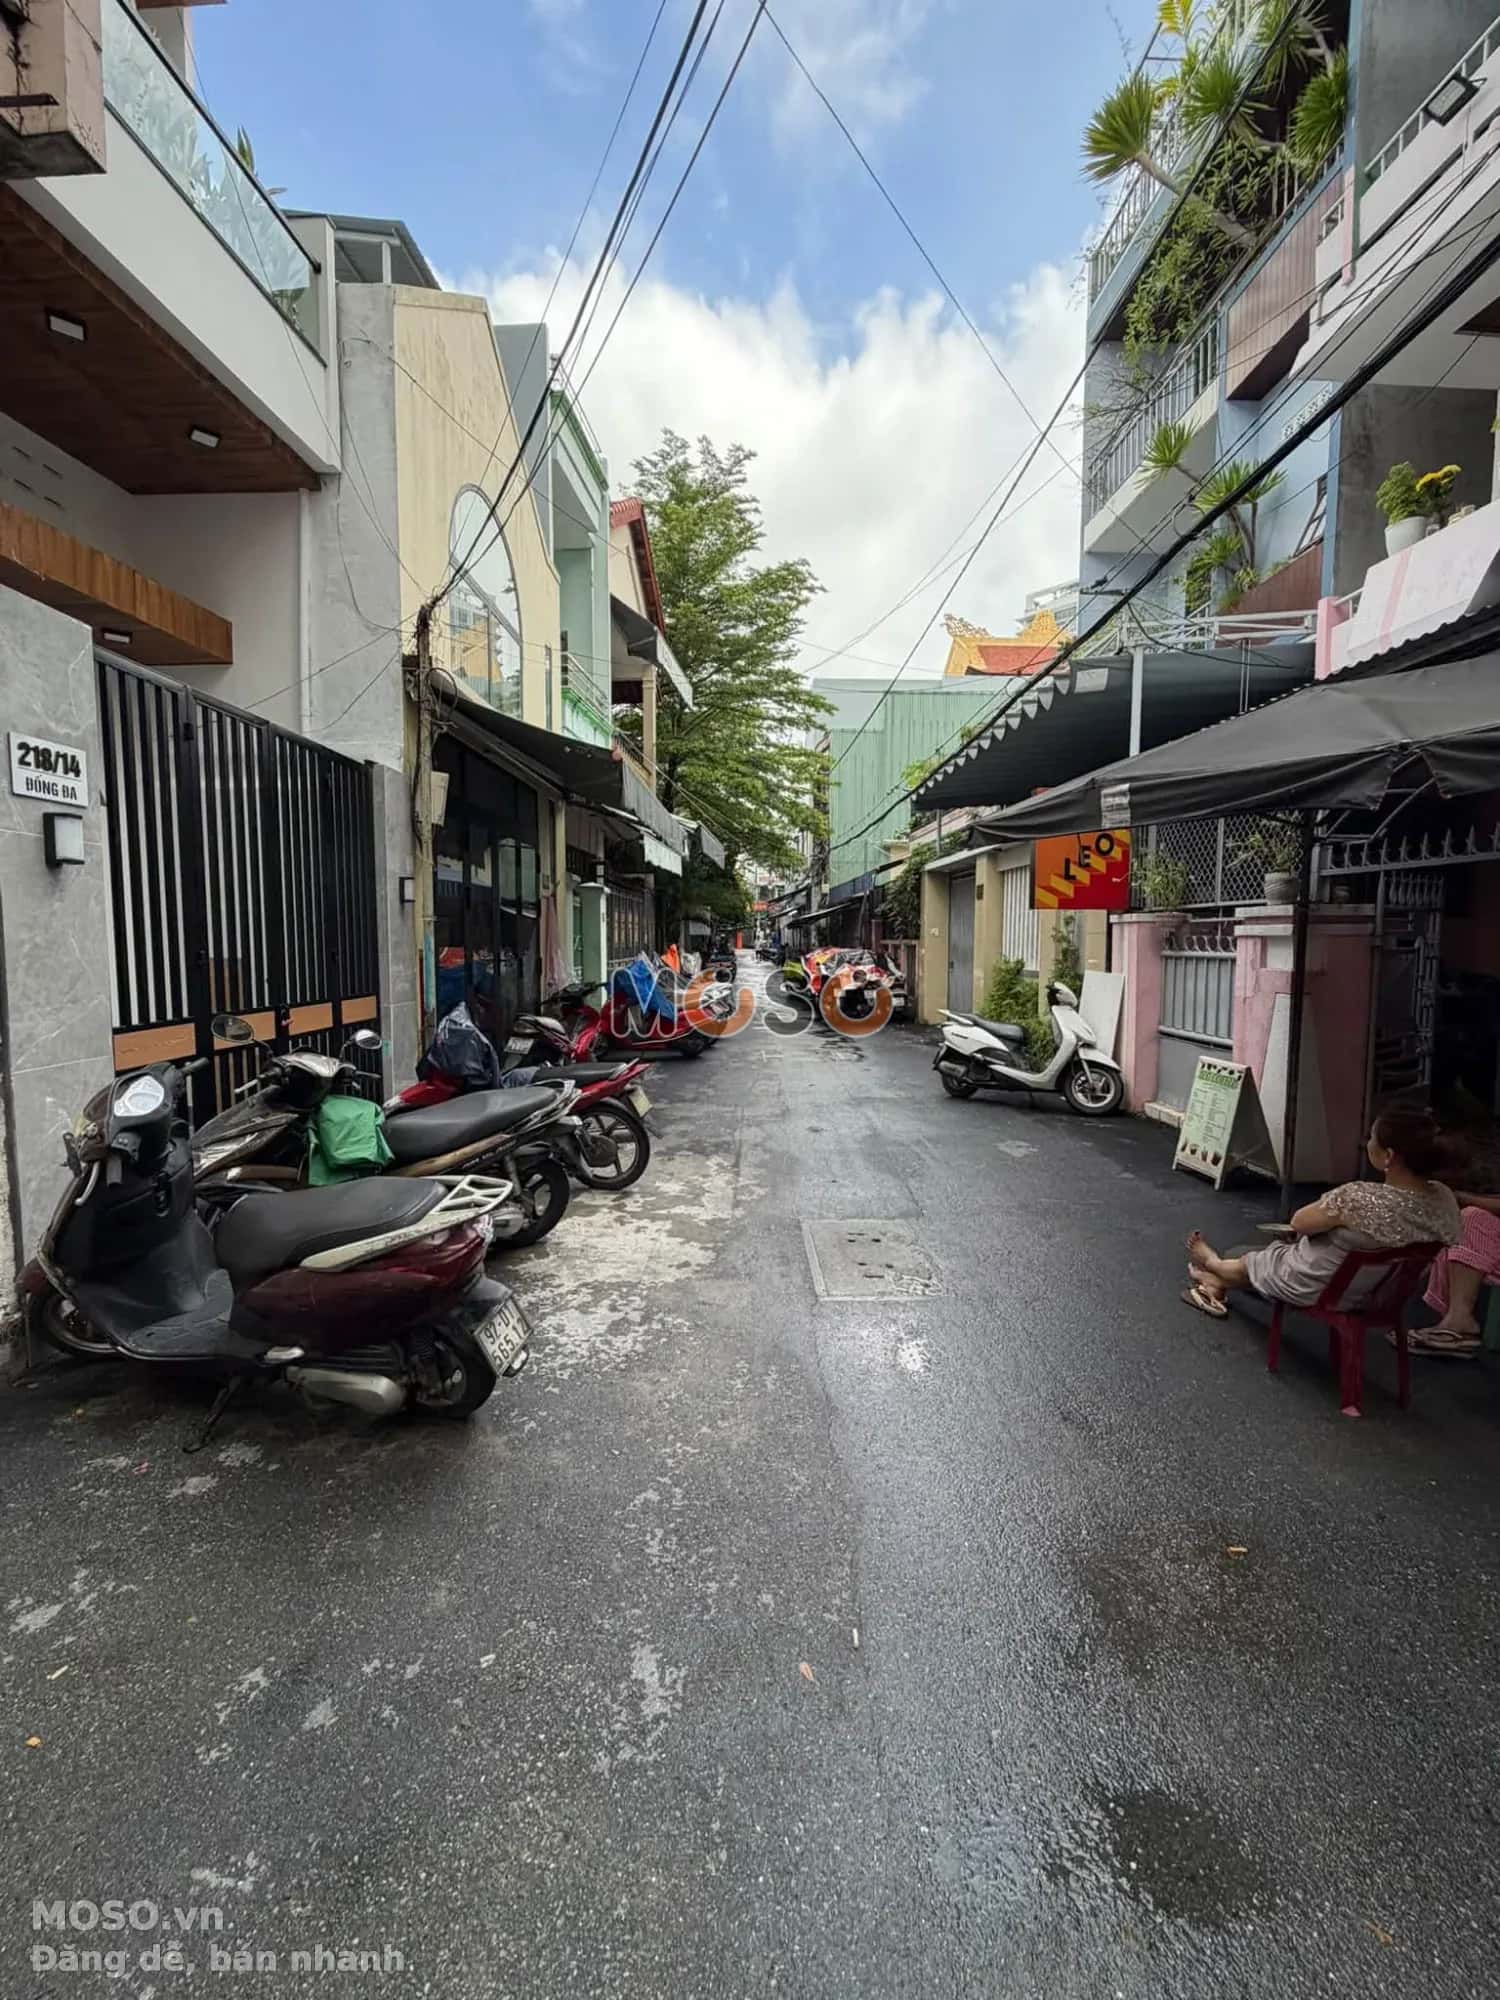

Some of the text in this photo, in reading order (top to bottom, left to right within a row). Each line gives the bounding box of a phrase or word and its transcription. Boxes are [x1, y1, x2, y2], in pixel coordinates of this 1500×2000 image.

[17, 742, 81, 777] 218/14
[26, 775, 77, 800] ĐỐNG ĐA
[1064, 832, 1114, 881] LEO
